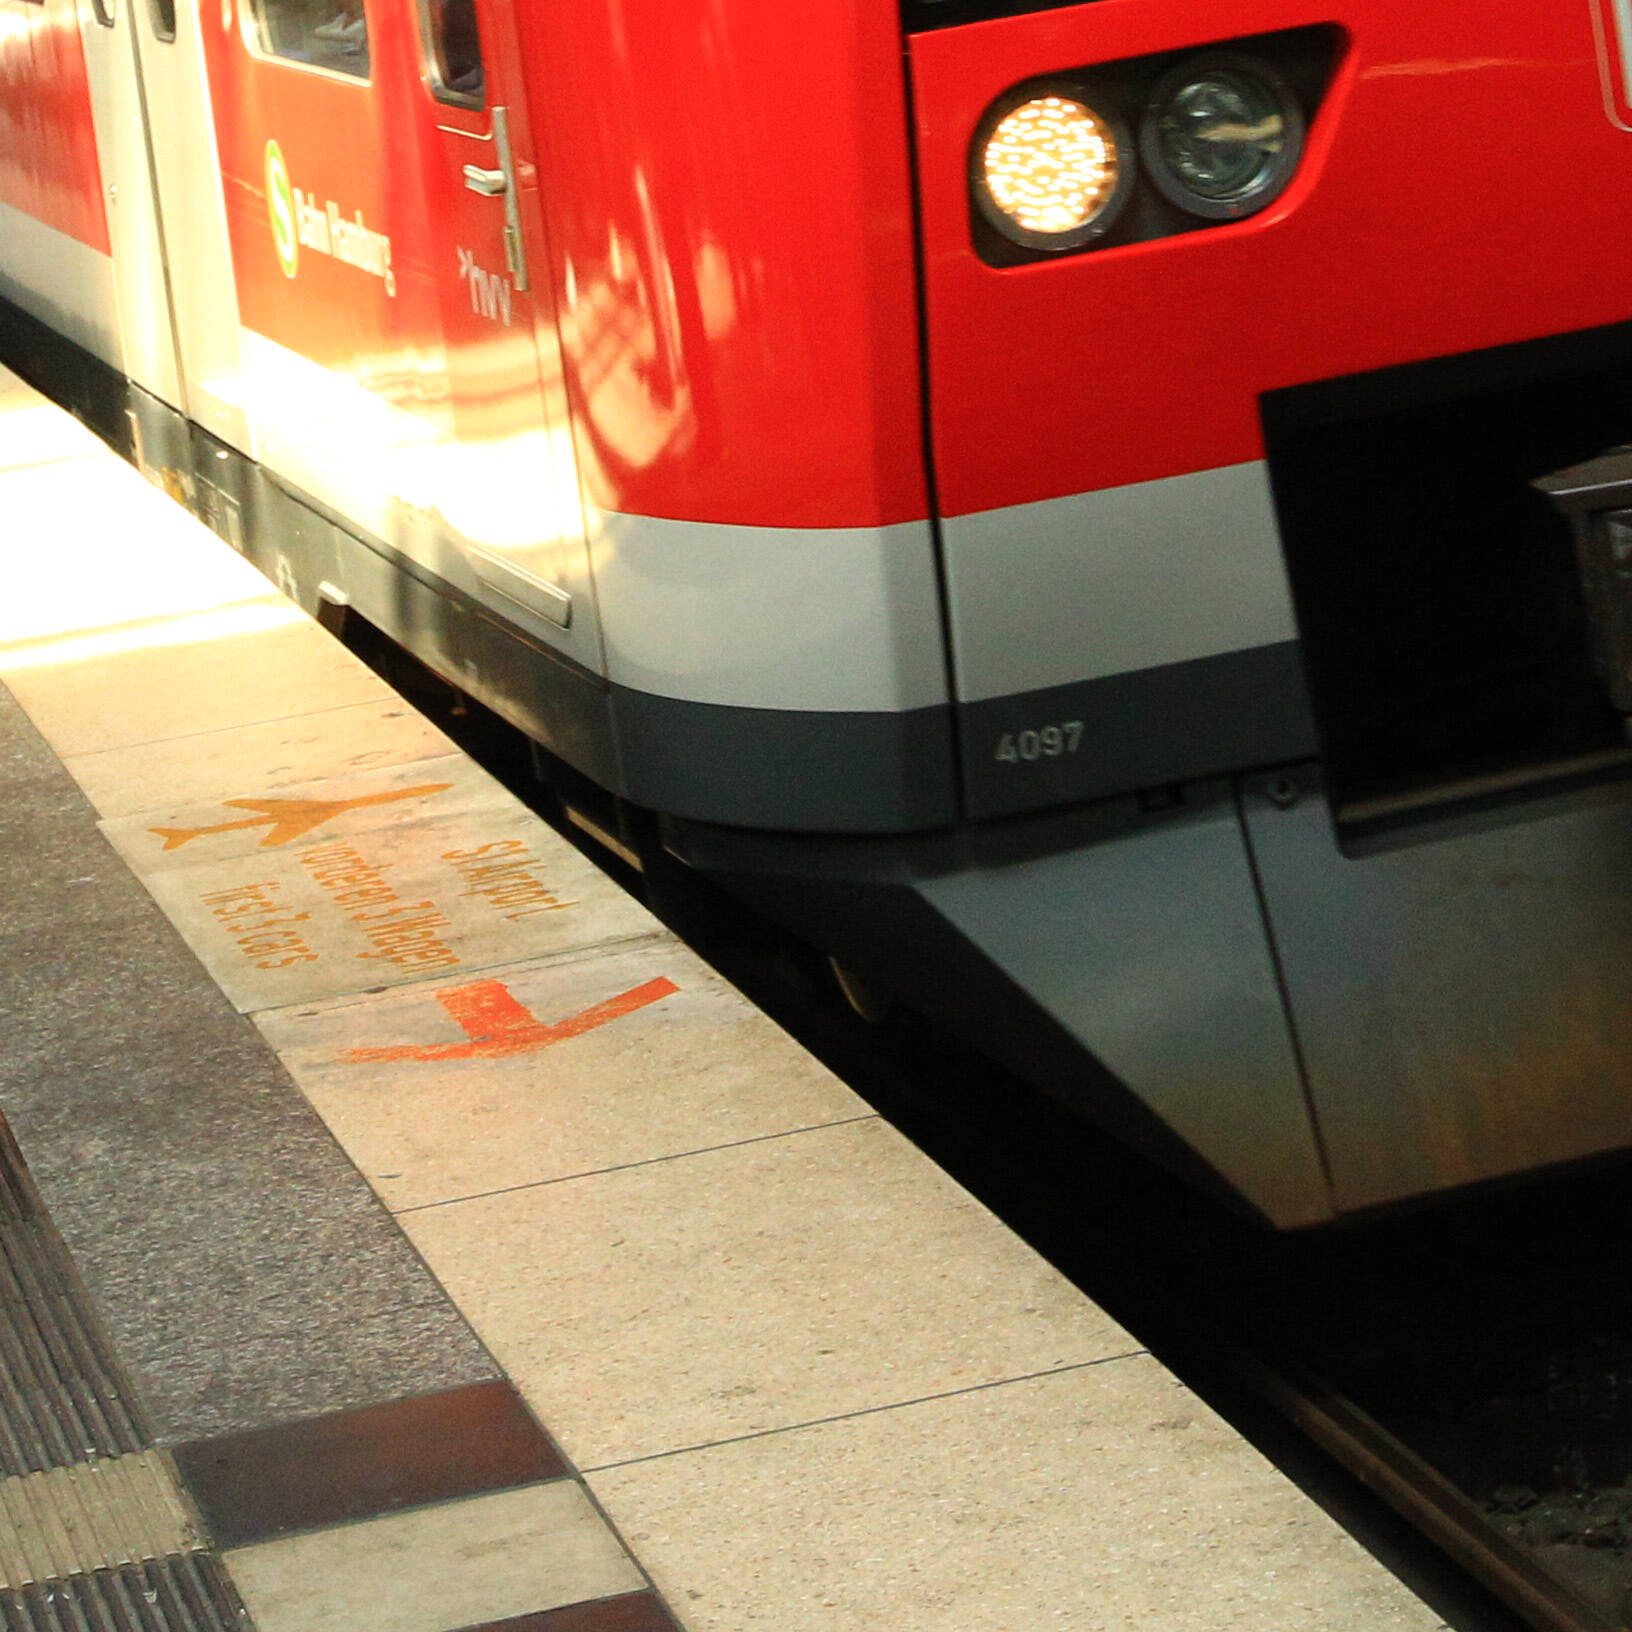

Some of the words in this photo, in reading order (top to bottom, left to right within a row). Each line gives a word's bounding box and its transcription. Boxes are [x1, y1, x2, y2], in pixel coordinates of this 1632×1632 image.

[294, 841, 399, 911] vorderen
[457, 859, 581, 920] Airport
[200, 881, 295, 923] first
[226, 912, 311, 934] 3
[350, 900, 436, 921] 3
[237, 930, 319, 969] cars
[355, 913, 461, 974] Wagen
